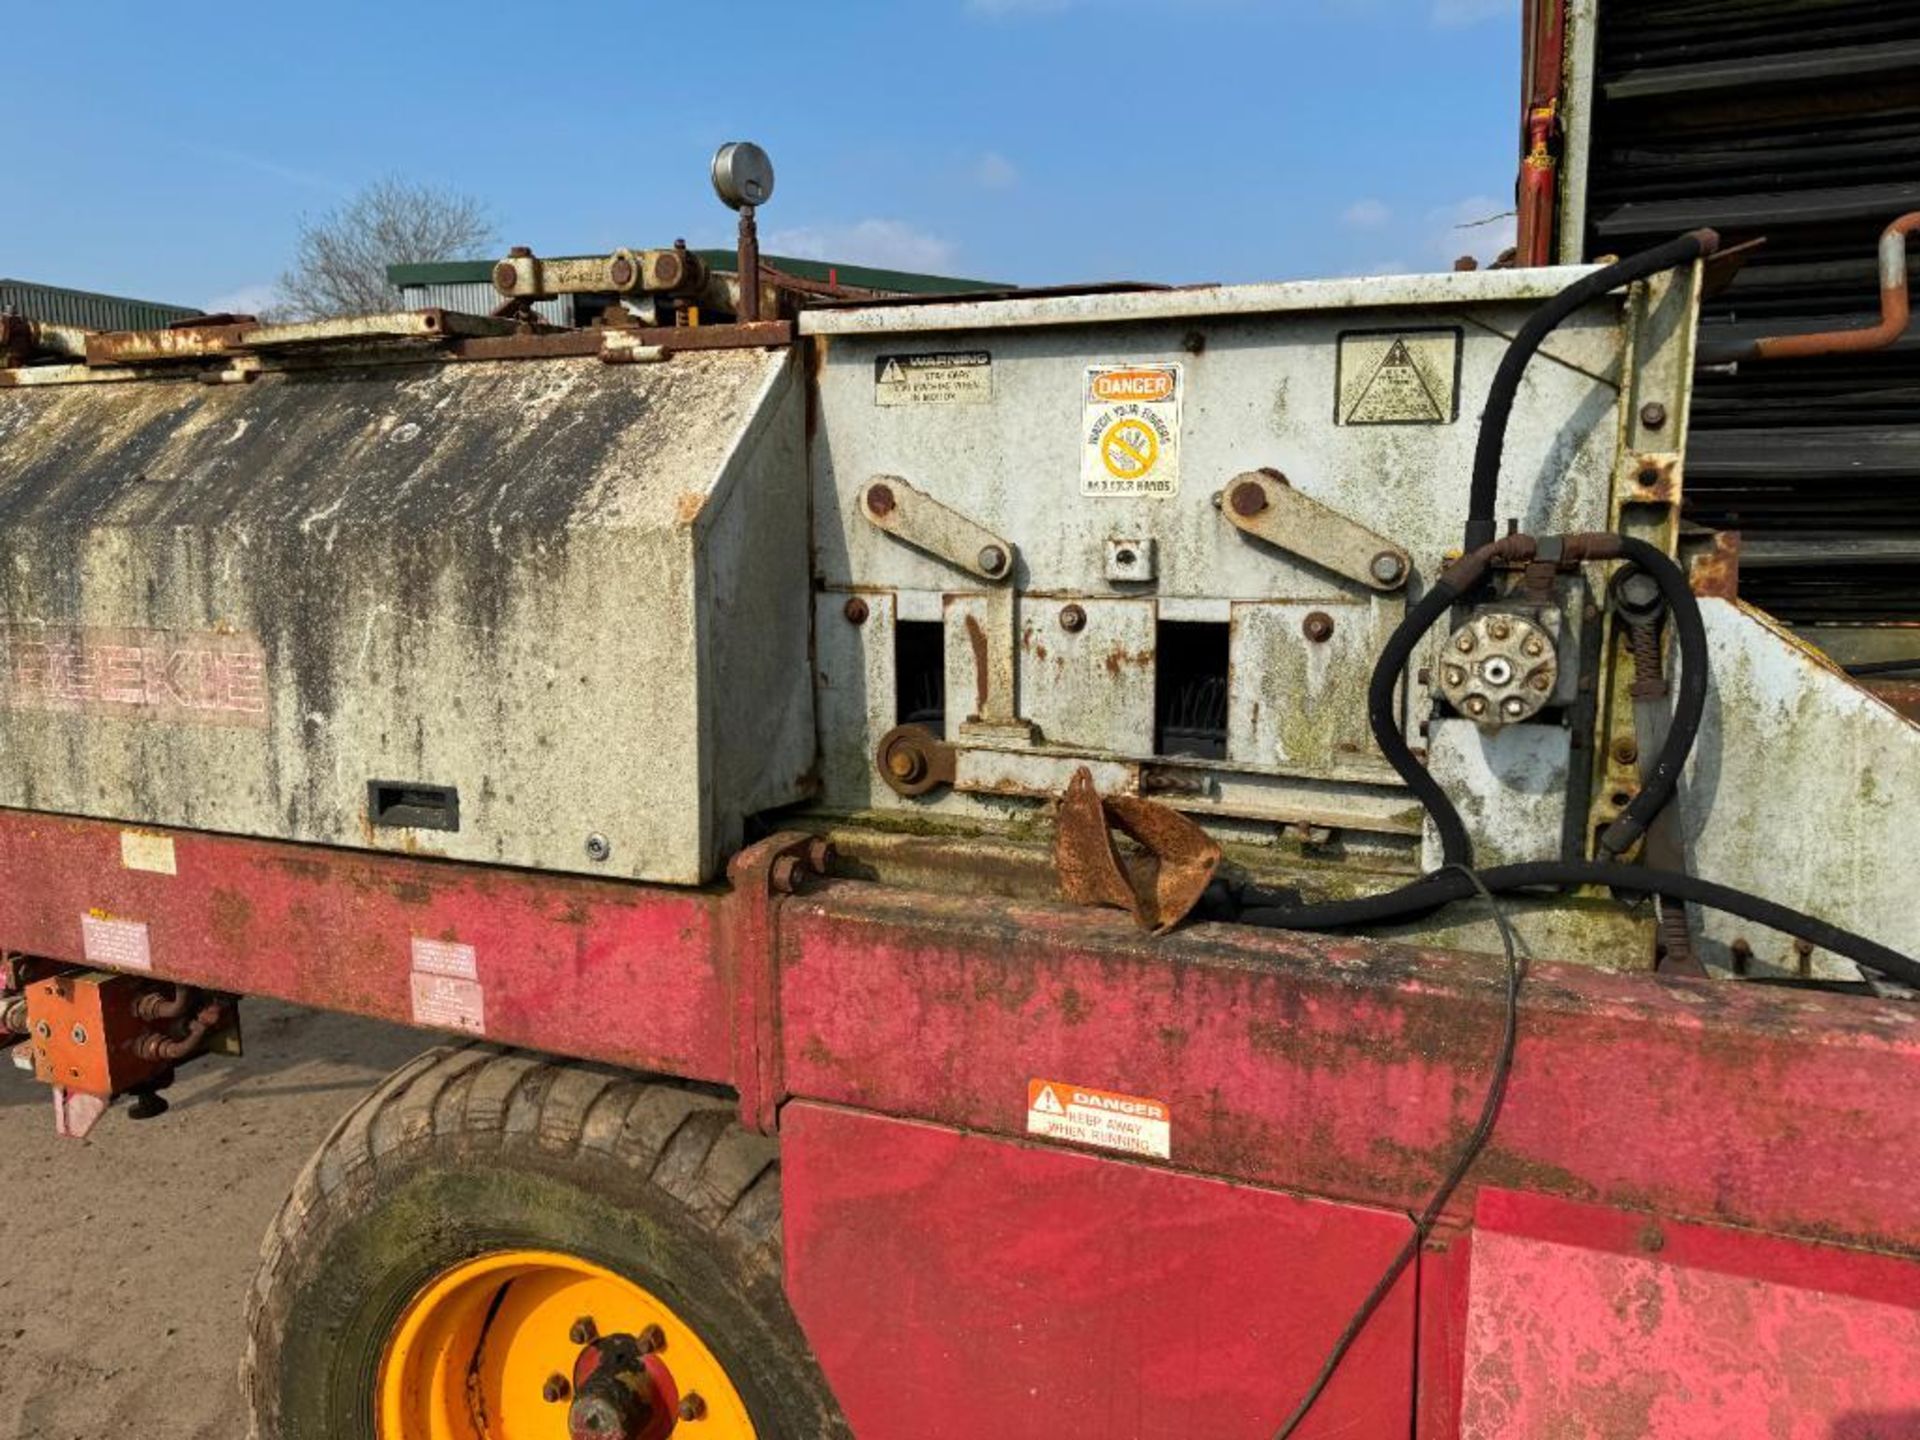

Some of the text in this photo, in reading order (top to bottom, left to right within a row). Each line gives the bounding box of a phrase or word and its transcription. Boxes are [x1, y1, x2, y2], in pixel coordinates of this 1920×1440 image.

[909, 354, 988, 366] WARNING
[1099, 377, 1167, 395] DANGER
[1136, 480, 1171, 491] HANDS
[1072, 1092, 1163, 1118] DANGER
[1068, 1112, 1143, 1136] KEEP AWAY
[1048, 1122, 1150, 1151] WHEN RUNNING
